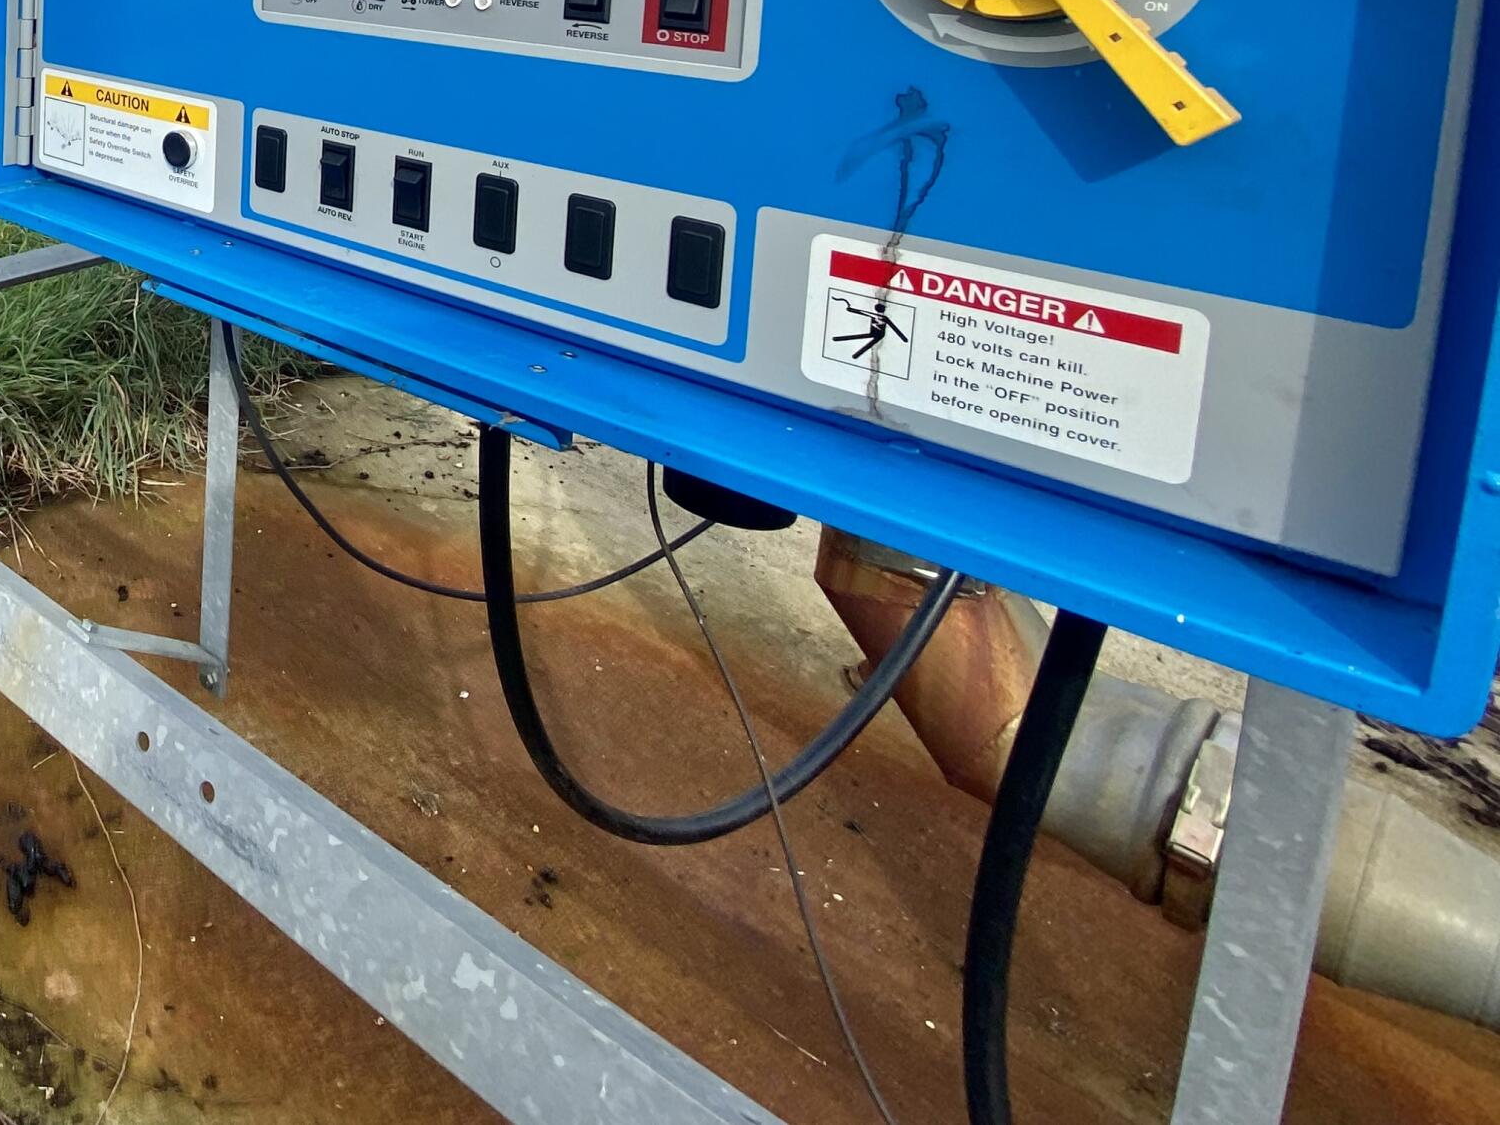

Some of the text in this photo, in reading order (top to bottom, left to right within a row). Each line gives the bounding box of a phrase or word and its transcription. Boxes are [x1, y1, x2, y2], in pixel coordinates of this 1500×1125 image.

[500, 0, 539, 9] REVERSE
[1144, 0, 1169, 13] ON
[566, 30, 609, 41] REVERSE
[673, 33, 709, 44] STOP
[96, 90, 149, 112] CAUTION
[90, 113, 151, 134] Structural damage can
[90, 127, 131, 141] occur when the
[321, 126, 360, 141] AUTO STOP
[89, 137, 151, 159] Safety Override Switch
[409, 149, 424, 157] RUN
[95, 151, 124, 164] depressed.
[492, 160, 509, 169] AUX
[173, 167, 195, 179] SAFETY
[169, 175, 198, 188] OVERRIDE
[317, 206, 352, 222] AUTO REV.
[400, 230, 423, 242] START
[398, 238, 425, 251] ENGINE
[922, 273, 1066, 323] DANGER
[940, 310, 1054, 345] High Voltage!
[938, 331, 1087, 376] 480 volts can kill.
[935, 350, 1119, 405] Lock Machine Power
[933, 371, 947, 384] in
[954, 376, 980, 392] the
[1045, 402, 1119, 429] position
[931, 391, 1121, 452] before opening cover.
